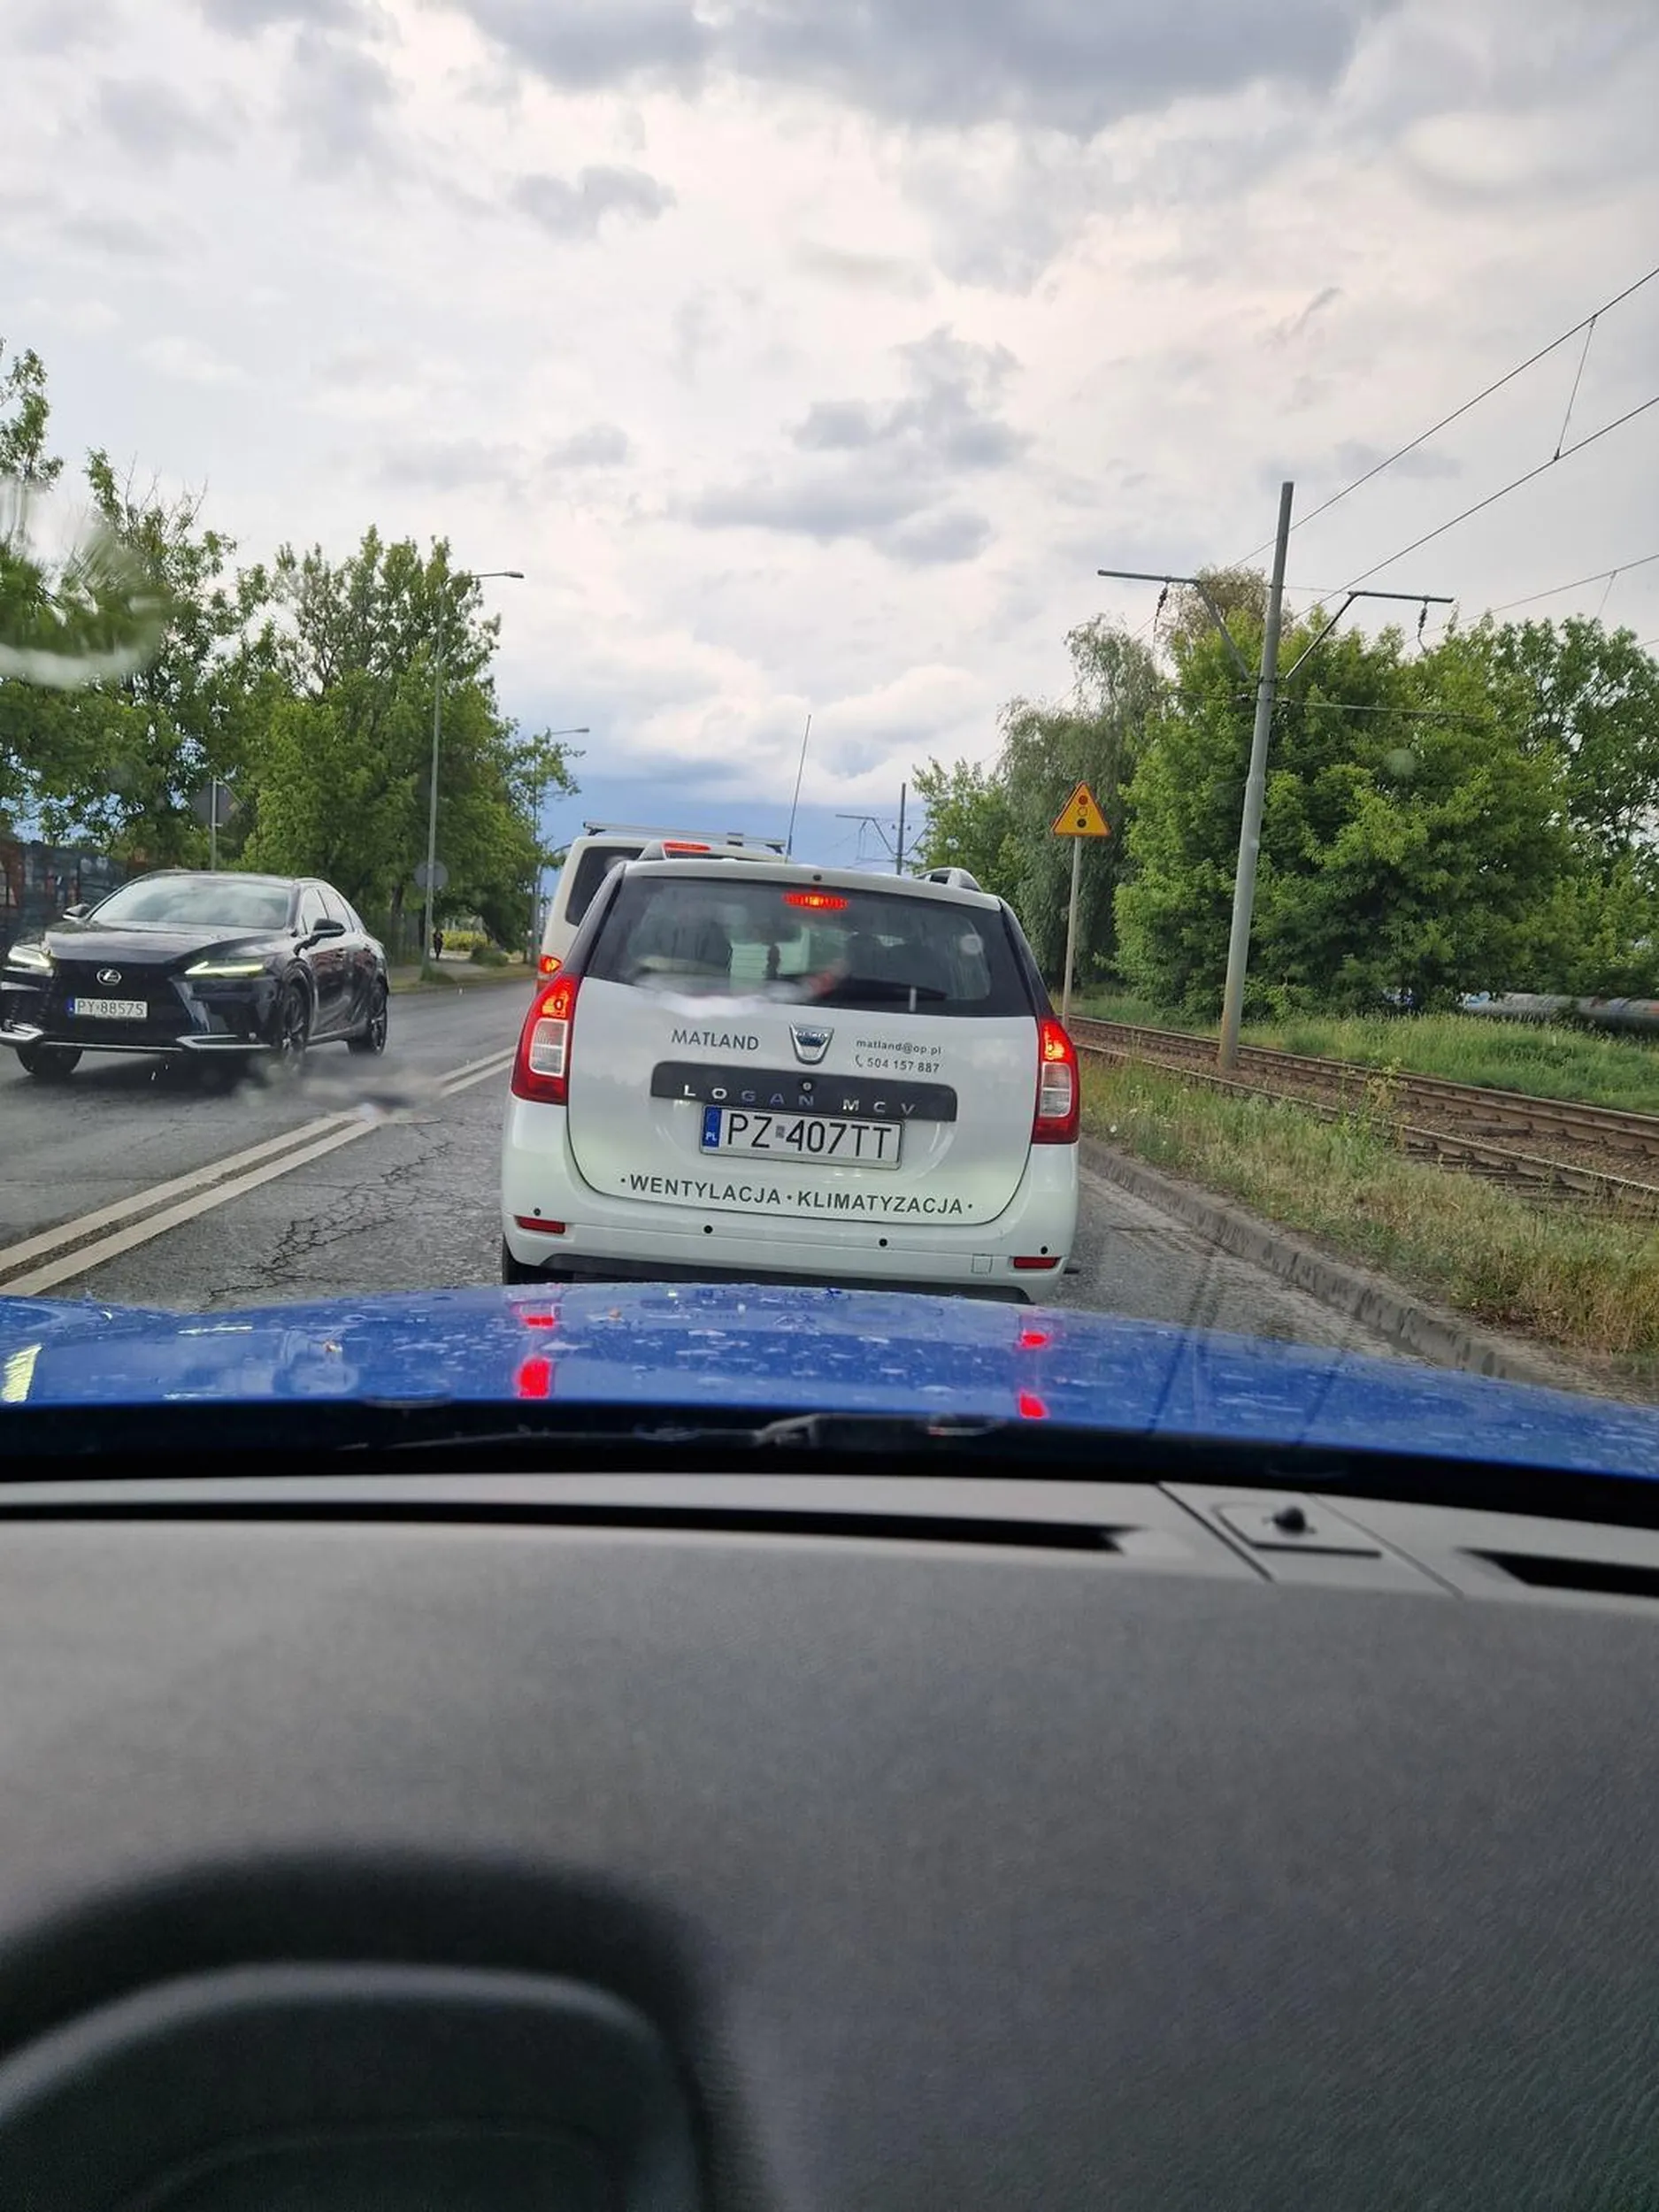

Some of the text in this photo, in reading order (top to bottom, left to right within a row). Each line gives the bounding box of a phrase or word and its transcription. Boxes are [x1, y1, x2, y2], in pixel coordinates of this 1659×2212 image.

[77, 1000, 144, 1017] PY 88575
[671, 1029, 759, 1051] MATLAND
[856, 1039, 941, 1056] matland@op.pl
[867, 1057, 940, 1073] 504 157 887
[683, 1085, 814, 1106] LOGAN
[705, 1132, 718, 1141] PL
[727, 1113, 892, 1159] PZ 407TT
[630, 1174, 963, 1215] WENTYLACJA KLIMATYZACJA
